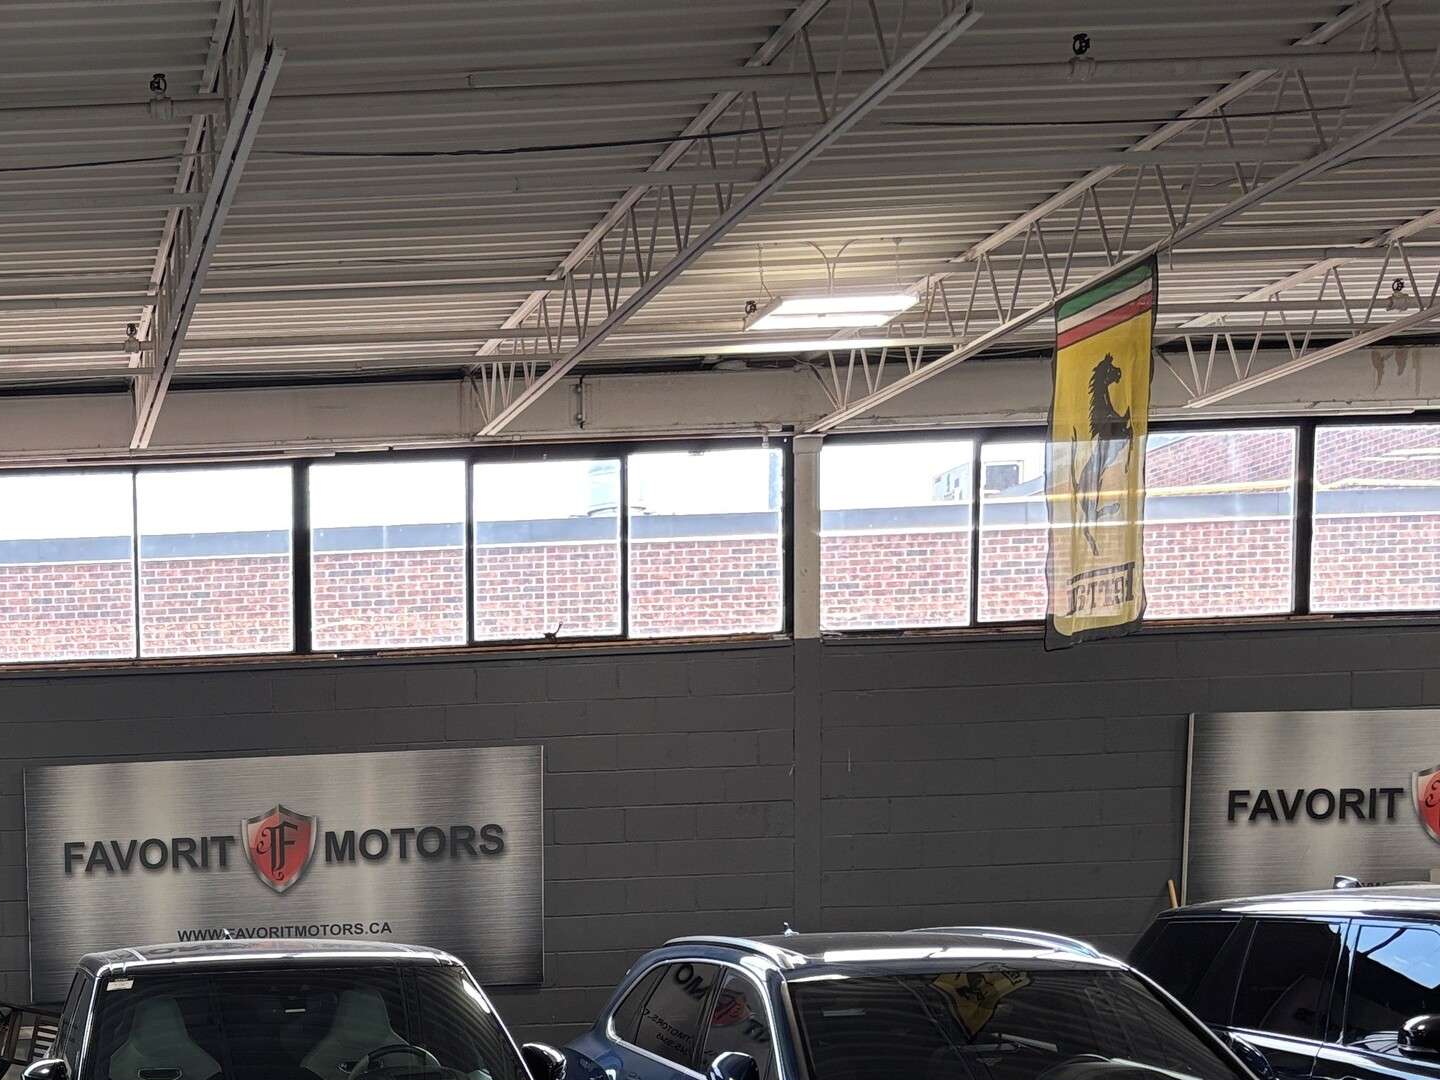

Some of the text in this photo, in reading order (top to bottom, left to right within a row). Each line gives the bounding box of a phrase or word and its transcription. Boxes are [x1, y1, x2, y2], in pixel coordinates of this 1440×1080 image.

[1227, 787, 1404, 822] FAVORIT
[63, 835, 236, 874] FAVORIT
[324, 823, 505, 863] MOTORS
[177, 922, 393, 943] WWWFAVORITMOTORS.CA
